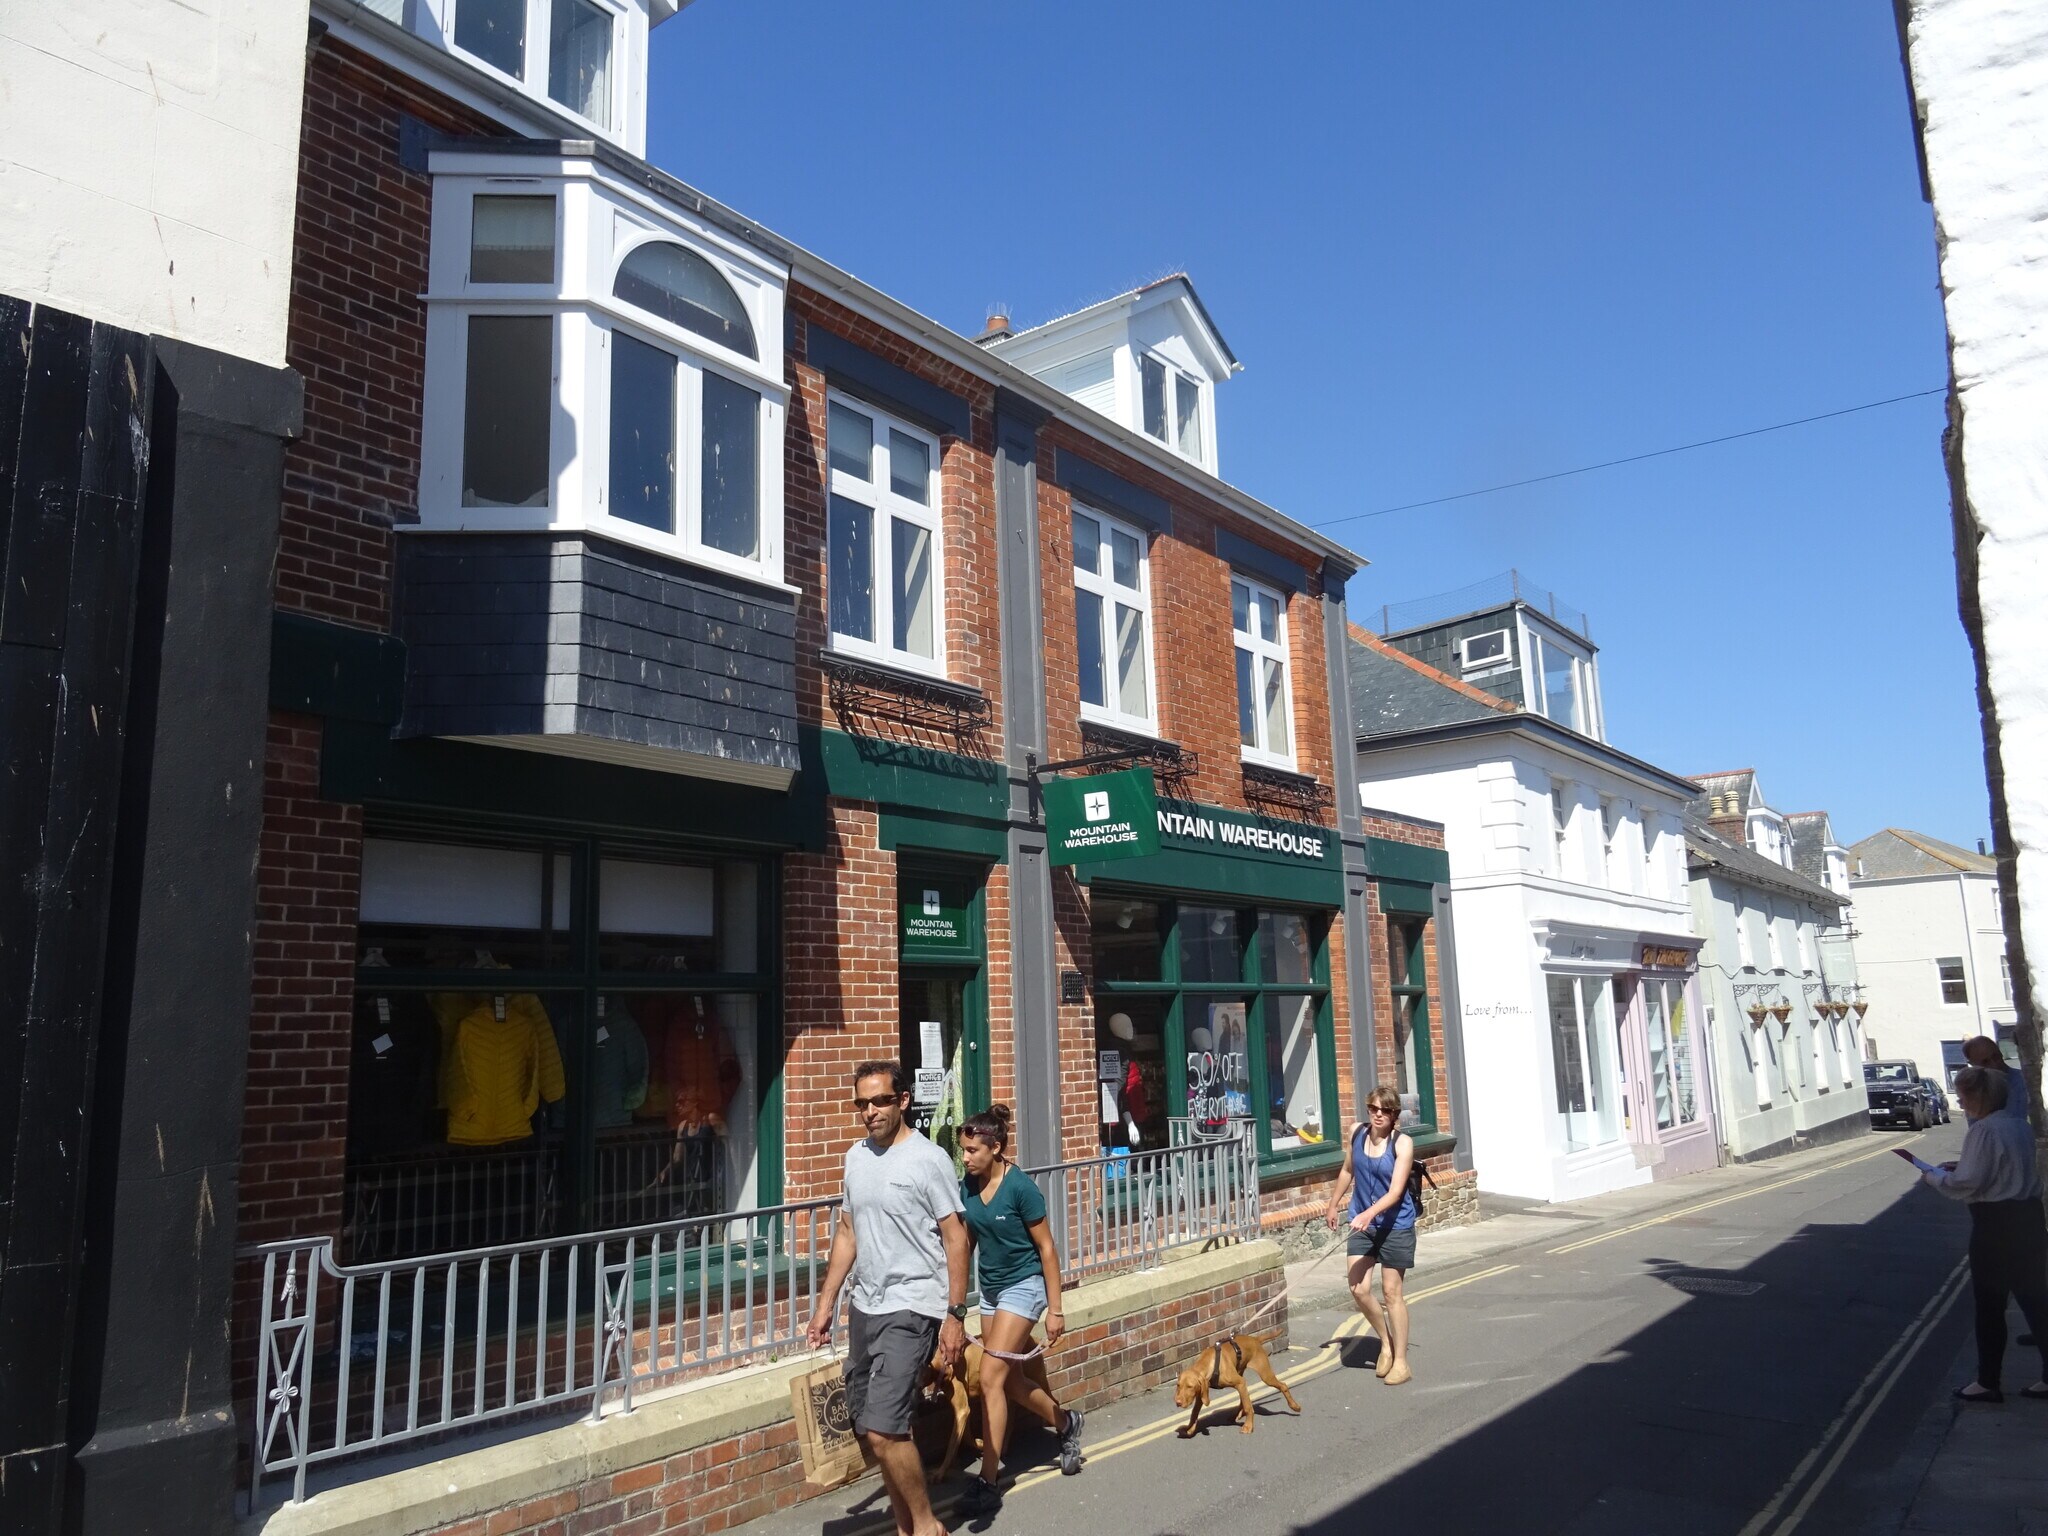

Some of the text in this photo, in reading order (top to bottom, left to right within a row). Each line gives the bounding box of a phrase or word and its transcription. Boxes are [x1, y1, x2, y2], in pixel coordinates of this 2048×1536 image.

[1069, 822, 1130, 837] MOUNTAIN
[1157, 810, 1324, 859] NTAIN WAREHOUSE
[1064, 831, 1139, 850] WAREHOUSE
[910, 918, 953, 929] MOUNTAIN
[906, 927, 958, 938] WAREHOUSE
[1465, 1003, 1491, 1016] Love
[1222, 1052, 1244, 1083] OFF
[920, 1073, 942, 1082] NOTICE
[831, 1401, 849, 1414] BAK
[829, 1410, 849, 1425] HOU
